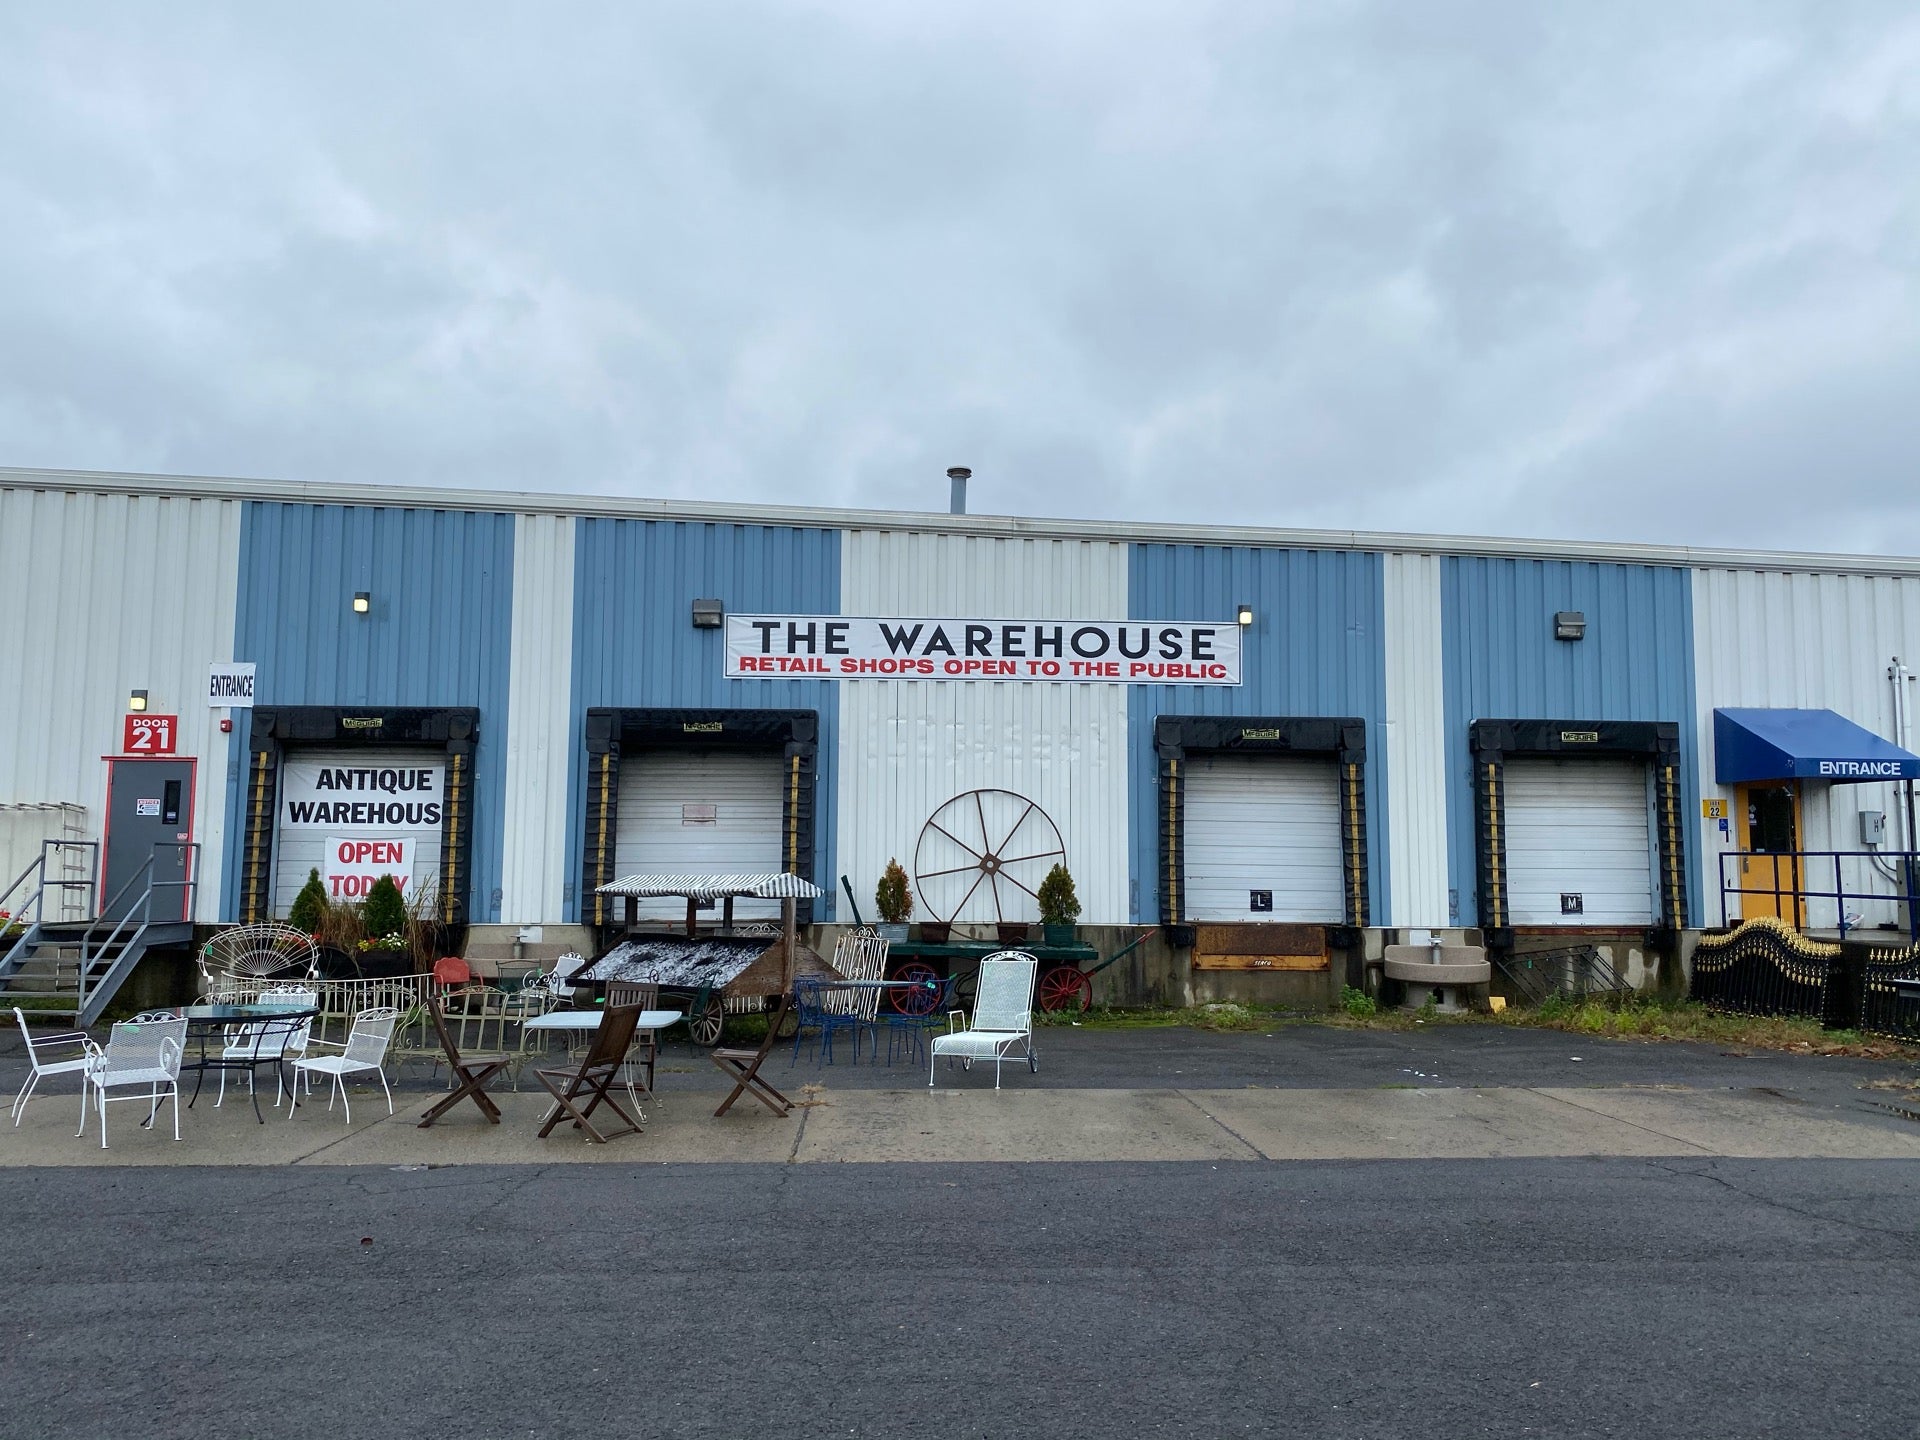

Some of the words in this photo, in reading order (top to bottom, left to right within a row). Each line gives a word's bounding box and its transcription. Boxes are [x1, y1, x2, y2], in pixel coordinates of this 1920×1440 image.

[752, 621, 850, 655] THE
[878, 623, 1216, 661] WAREHOUSE
[739, 656, 831, 673] RETAIL
[840, 658, 935, 675] SHOPS
[944, 659, 1016, 675] OPEN
[1026, 661, 1060, 676] TO
[1069, 661, 1120, 677] THE
[1130, 662, 1227, 679] PUBLIC
[210, 675, 254, 697] ENTRANCE
[132, 719, 169, 727] DOOR
[131, 727, 169, 749] 21
[1820, 761, 1901, 775] ENTRANCE
[316, 769, 433, 794] ANTIQUE
[289, 801, 441, 825] WAREHOUS
[1710, 807, 1720, 817] 22
[338, 842, 403, 864] OPEN
[329, 875, 409, 897] TODY
[1257, 894, 1265, 907] L
[1568, 897, 1577, 909] M
